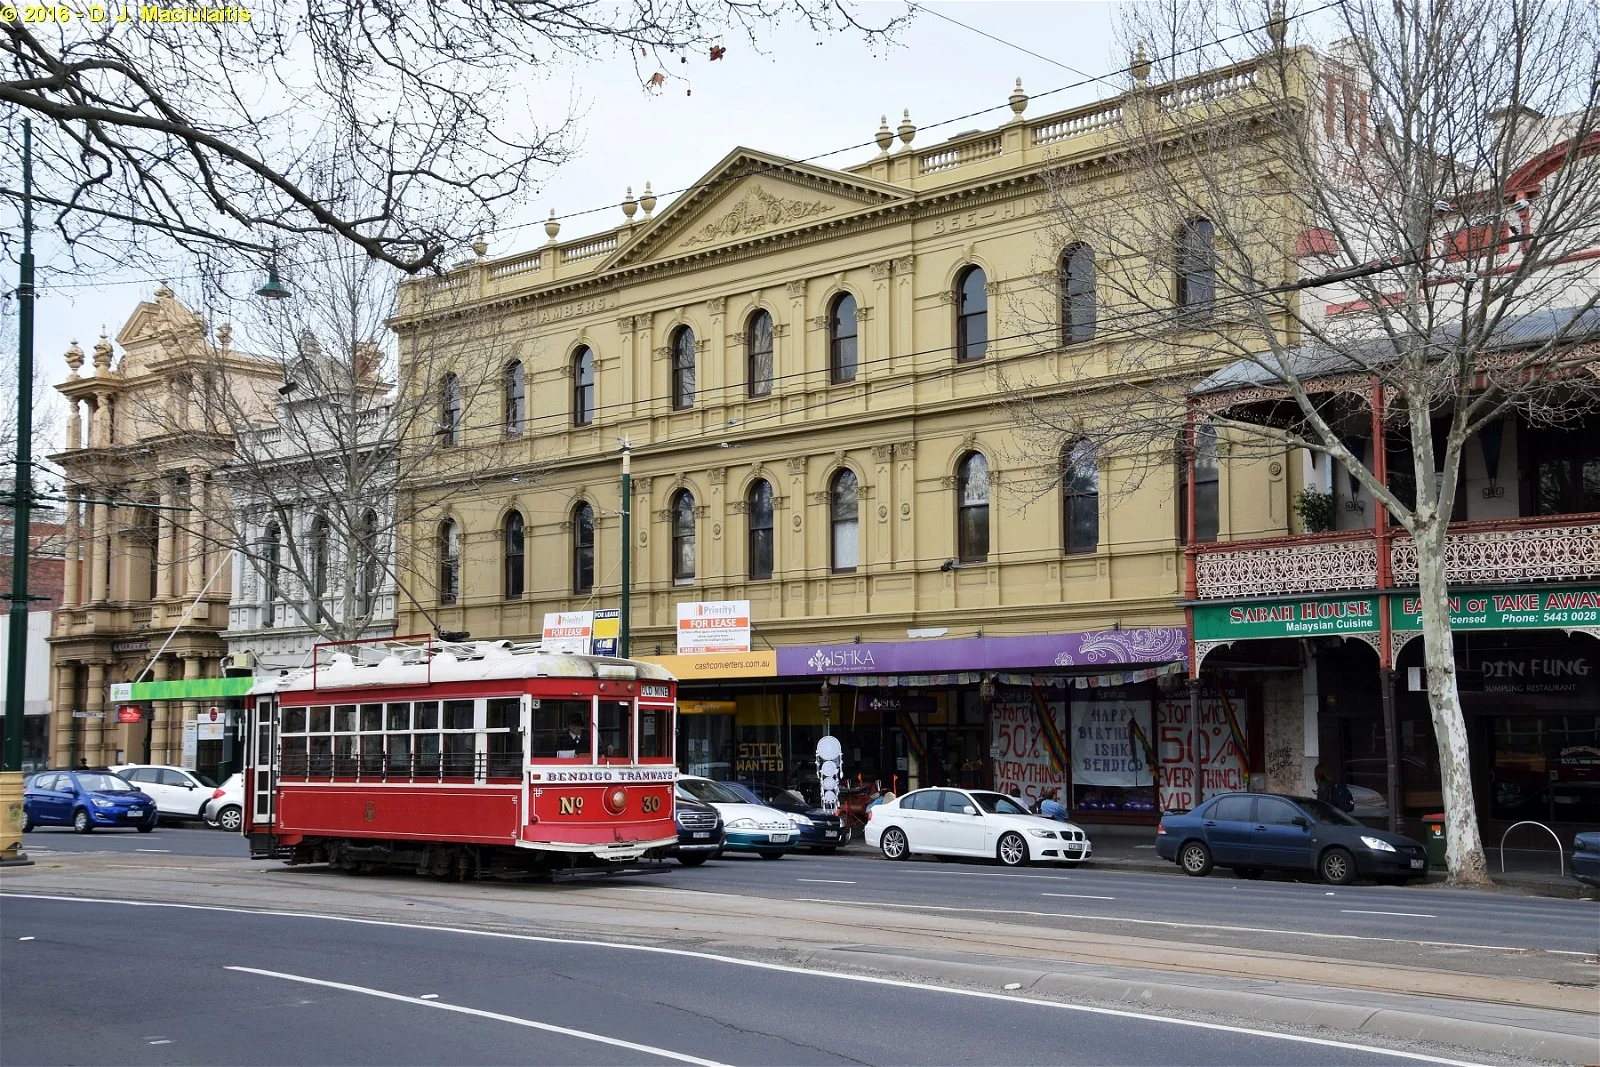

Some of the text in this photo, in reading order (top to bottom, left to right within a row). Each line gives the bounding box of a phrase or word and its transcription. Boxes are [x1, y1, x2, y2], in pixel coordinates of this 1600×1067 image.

[704, 605, 736, 614] Priority1
[1403, 598, 1422, 614] EA
[1467, 599, 1488, 612] or
[1492, 594, 1540, 611] TAKE
[1230, 600, 1372, 624] SABAH HOUSE
[1449, 611, 1597, 624] icensed Phone: 5443 0028
[690, 618, 737, 628] FOR LEASE
[1286, 619, 1373, 632] Malaysian Cuisine
[551, 628, 583, 637] FOR LEASE
[830, 650, 875, 666] ISHKA
[695, 660, 770, 670] cashconverters.com.au
[1482, 658, 1592, 678] DIN FUNG
[641, 686, 668, 697] OLD MINE
[1526, 684, 1576, 692] RESTAURANT
[1091, 709, 1136, 722] HAPPY
[1079, 726, 1148, 740] BIRTHDY
[999, 724, 1041, 758] 50%
[739, 743, 782, 758] STOCK
[1095, 743, 1132, 756] ISHK
[736, 760, 783, 771] WANTED
[1083, 758, 1143, 772] BENDIGO
[547, 771, 673, 781] BENDIGO TRAMWAYS
[642, 796, 661, 813] 30
